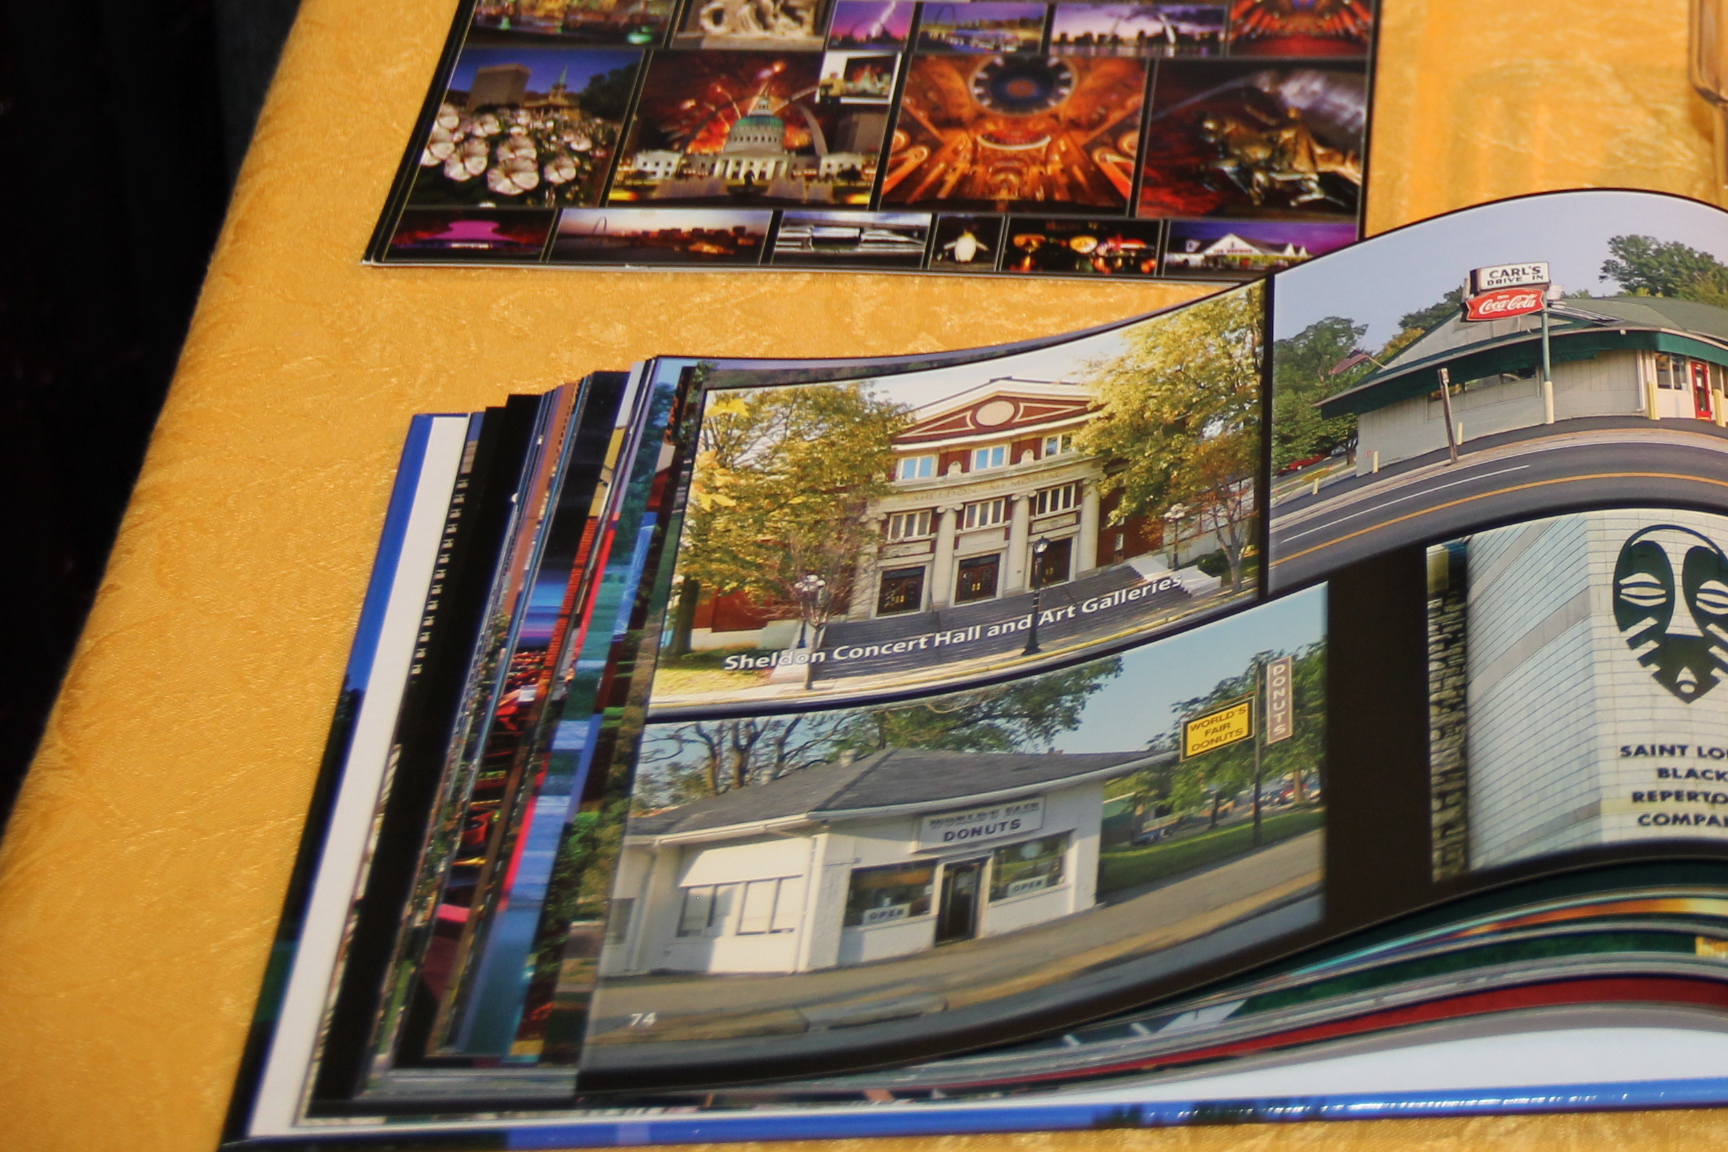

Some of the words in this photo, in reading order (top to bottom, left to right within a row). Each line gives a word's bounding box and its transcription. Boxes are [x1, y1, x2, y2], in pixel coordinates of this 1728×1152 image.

[1489, 266, 1541, 279] CARL'S
[1487, 276, 1522, 286] DRIVE
[724, 650, 827, 671] Sheldon
[833, 634, 928, 661] Concert
[934, 623, 981, 647] Hall
[987, 614, 1032, 636] and
[1037, 605, 1076, 627] Art
[1081, 574, 1183, 614] Galleries
[1272, 664, 1287, 734] DONUTS
[1189, 707, 1247, 732] WORLD'S
[1204, 722, 1231, 737] FAIR
[1191, 728, 1244, 752] DONUTS
[1619, 744, 1688, 759] SAINT
[943, 819, 1021, 842] DONUTS
[1012, 879, 1043, 893] OPEN
[869, 908, 905, 920] OPEN
[631, 1012, 656, 1027] 74
